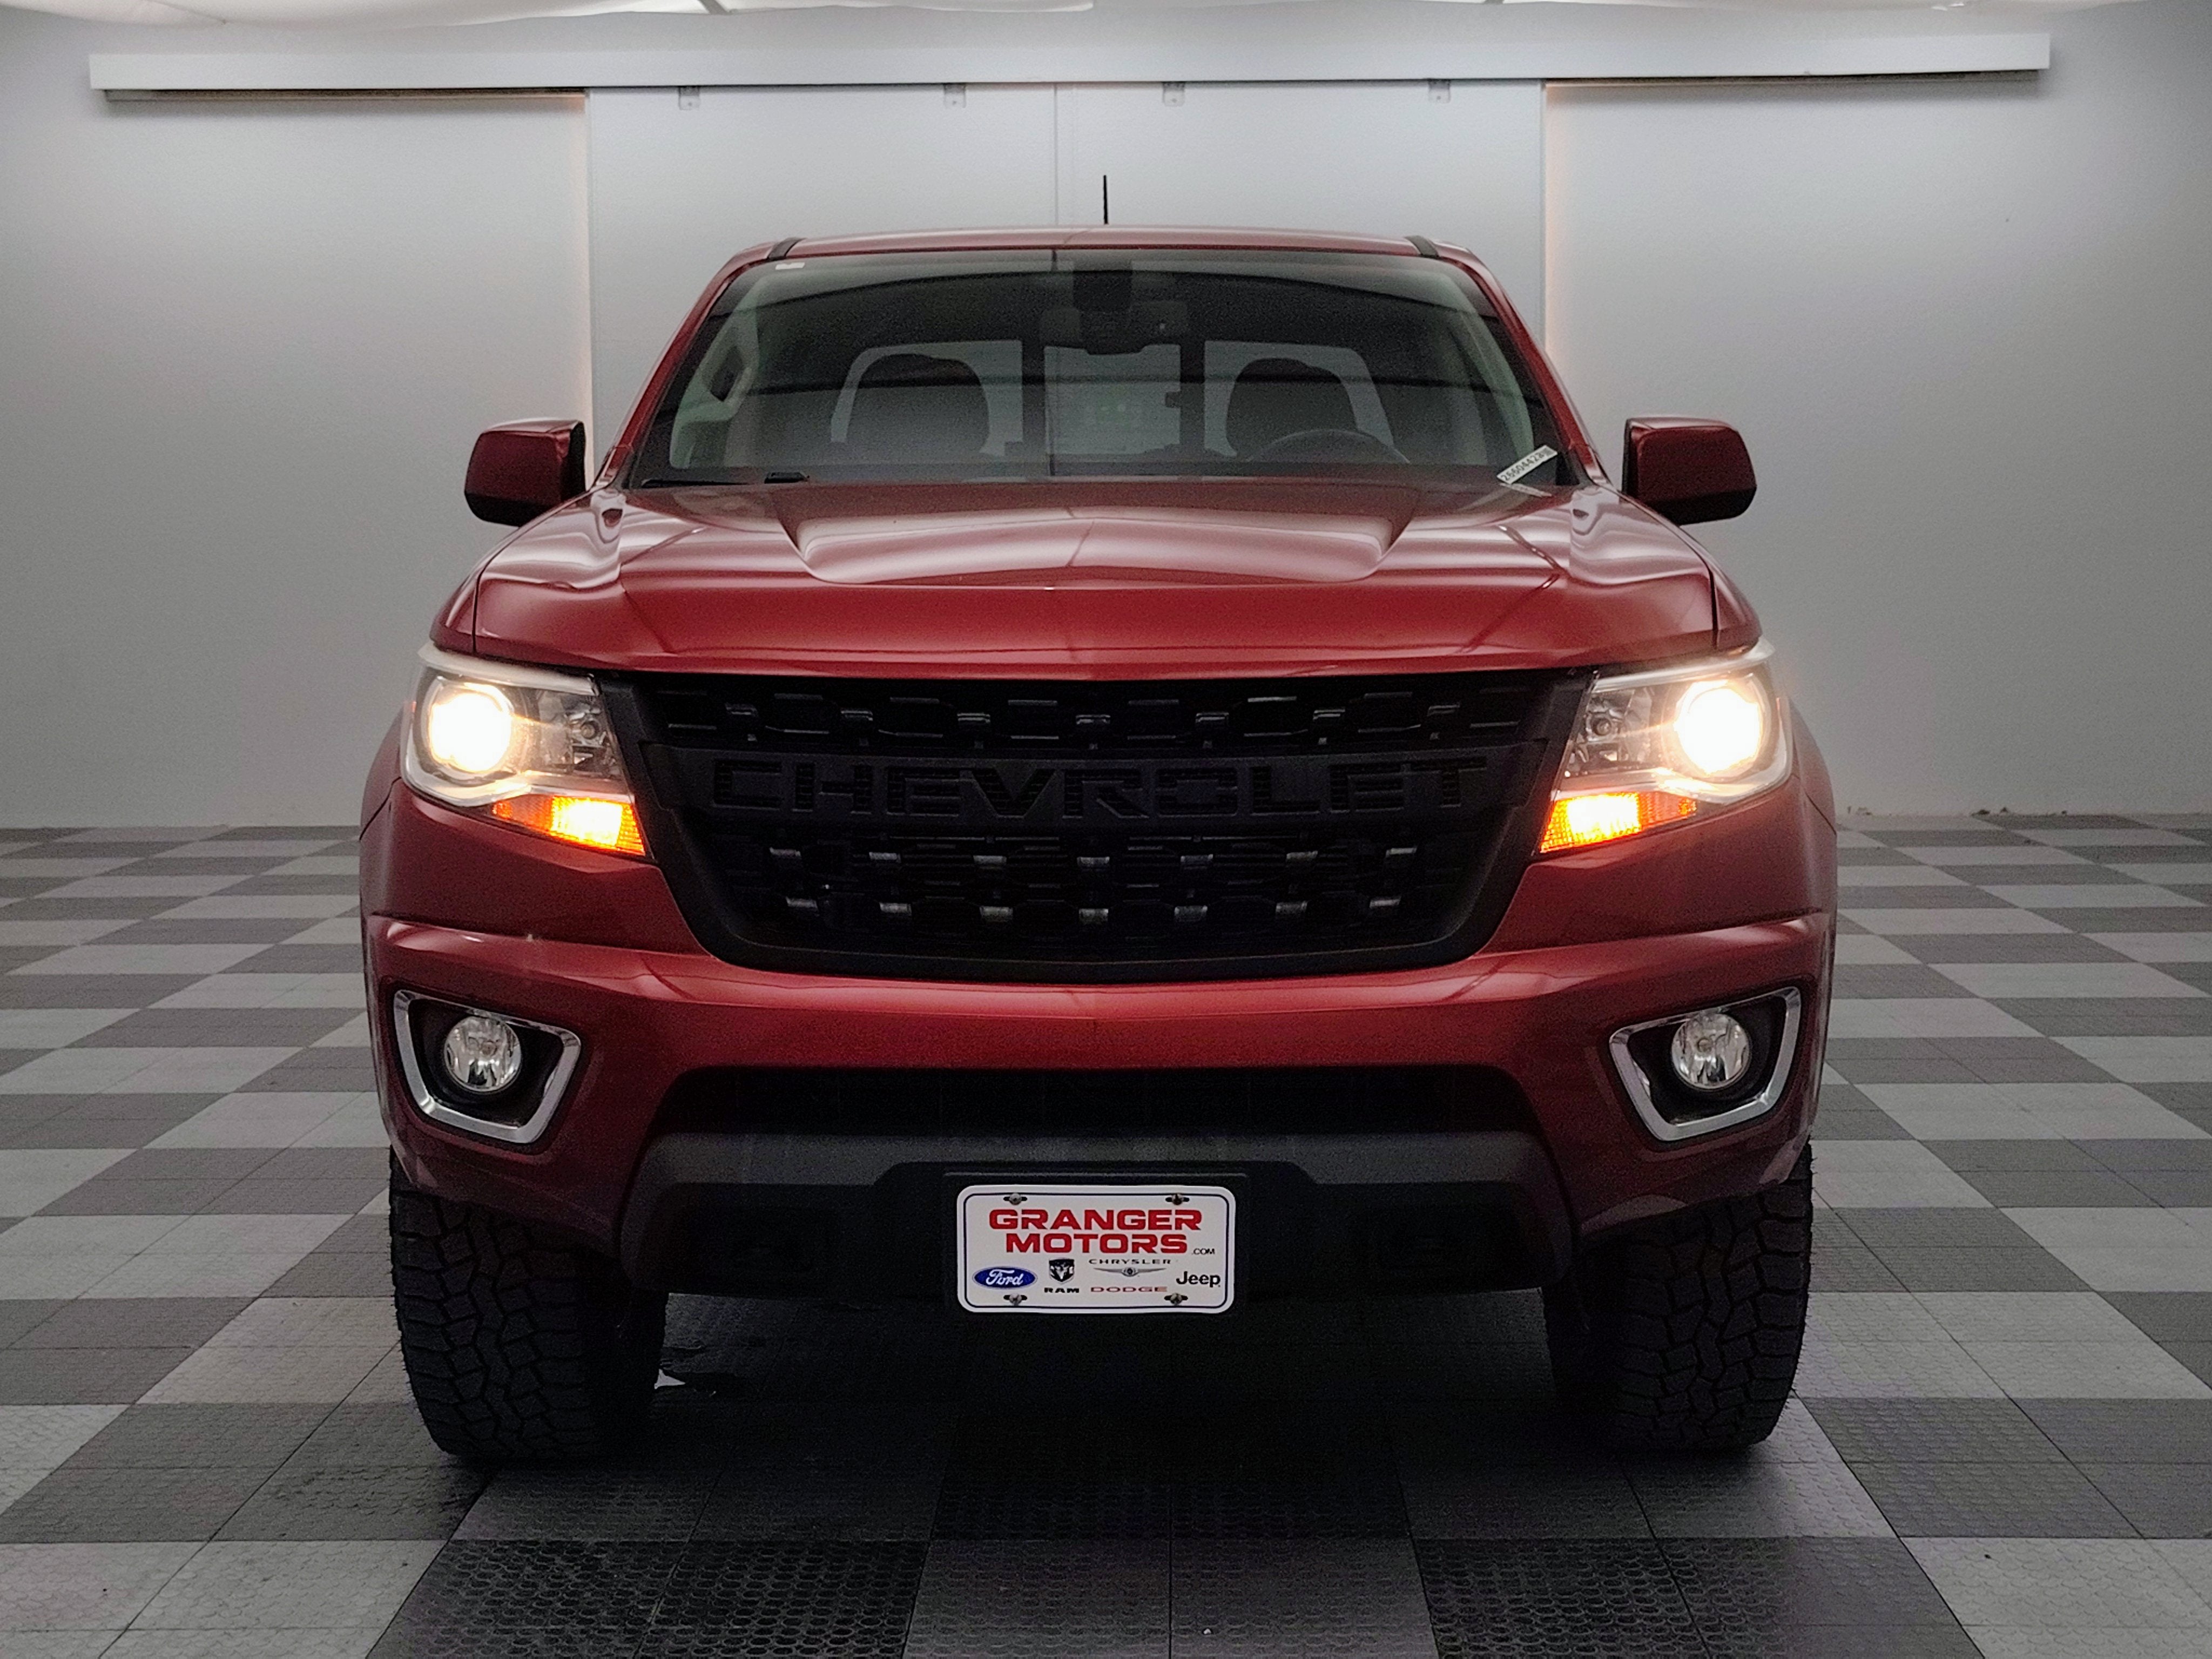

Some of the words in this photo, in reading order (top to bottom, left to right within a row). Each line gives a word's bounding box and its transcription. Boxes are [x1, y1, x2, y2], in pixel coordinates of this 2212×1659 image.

[713, 757, 1486, 818] CHEVROLET
[988, 1209, 1202, 1231] GRANGER
[1006, 1233, 1188, 1254] MOTORS
[986, 1269, 1024, 1286] Ford
[1176, 1271, 1221, 1287] Jeep
